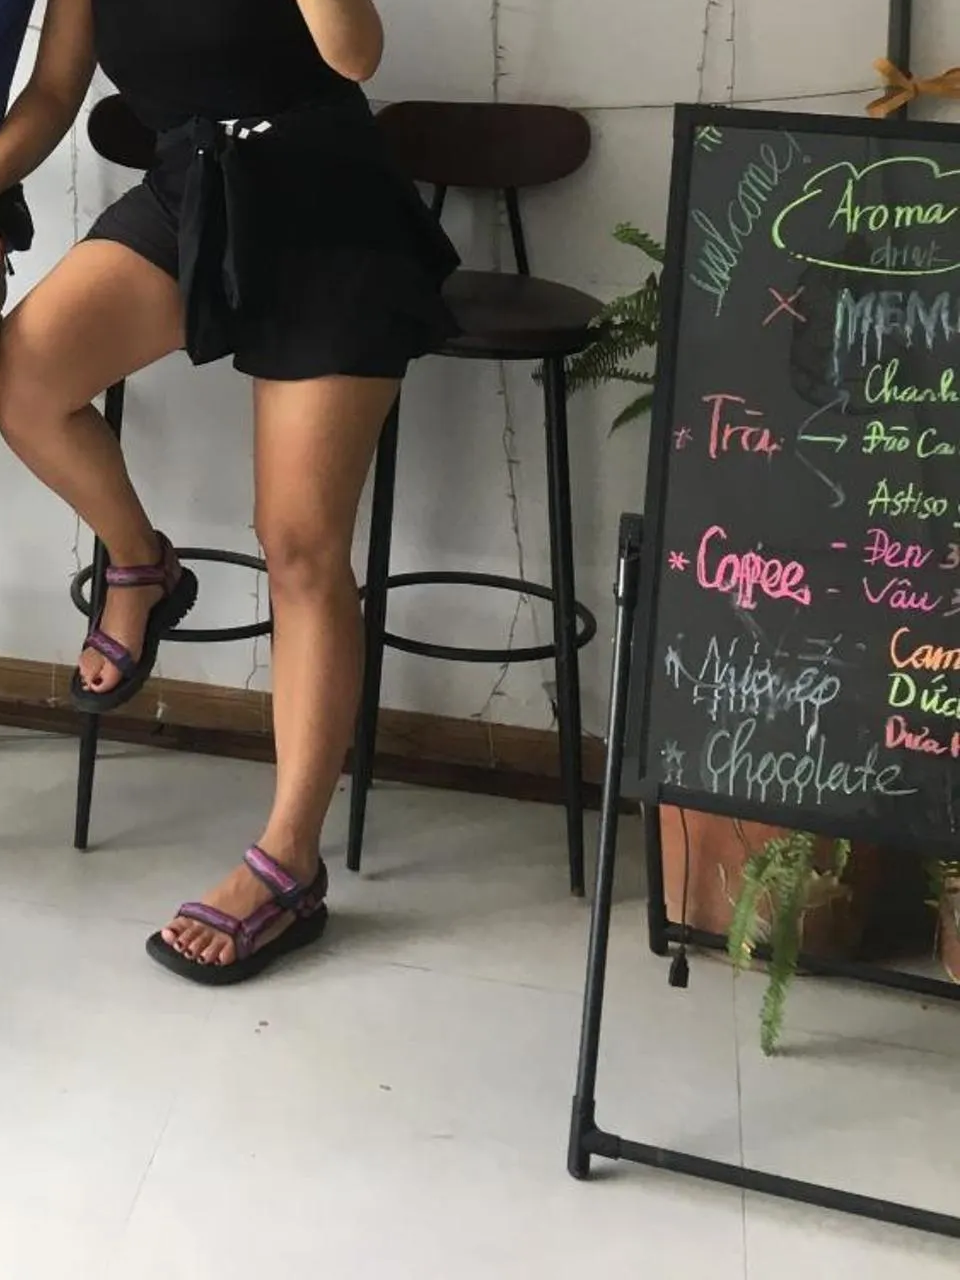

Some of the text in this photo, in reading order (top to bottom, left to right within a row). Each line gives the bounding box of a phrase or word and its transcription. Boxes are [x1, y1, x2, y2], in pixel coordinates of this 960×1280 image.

[828, 178, 958, 233] Aroma
[833, 287, 960, 354] MEN
[865, 358, 960, 404] Chanh
[916, 428, 960, 458] Ca
[707, 718, 918, 798] Chocolate
